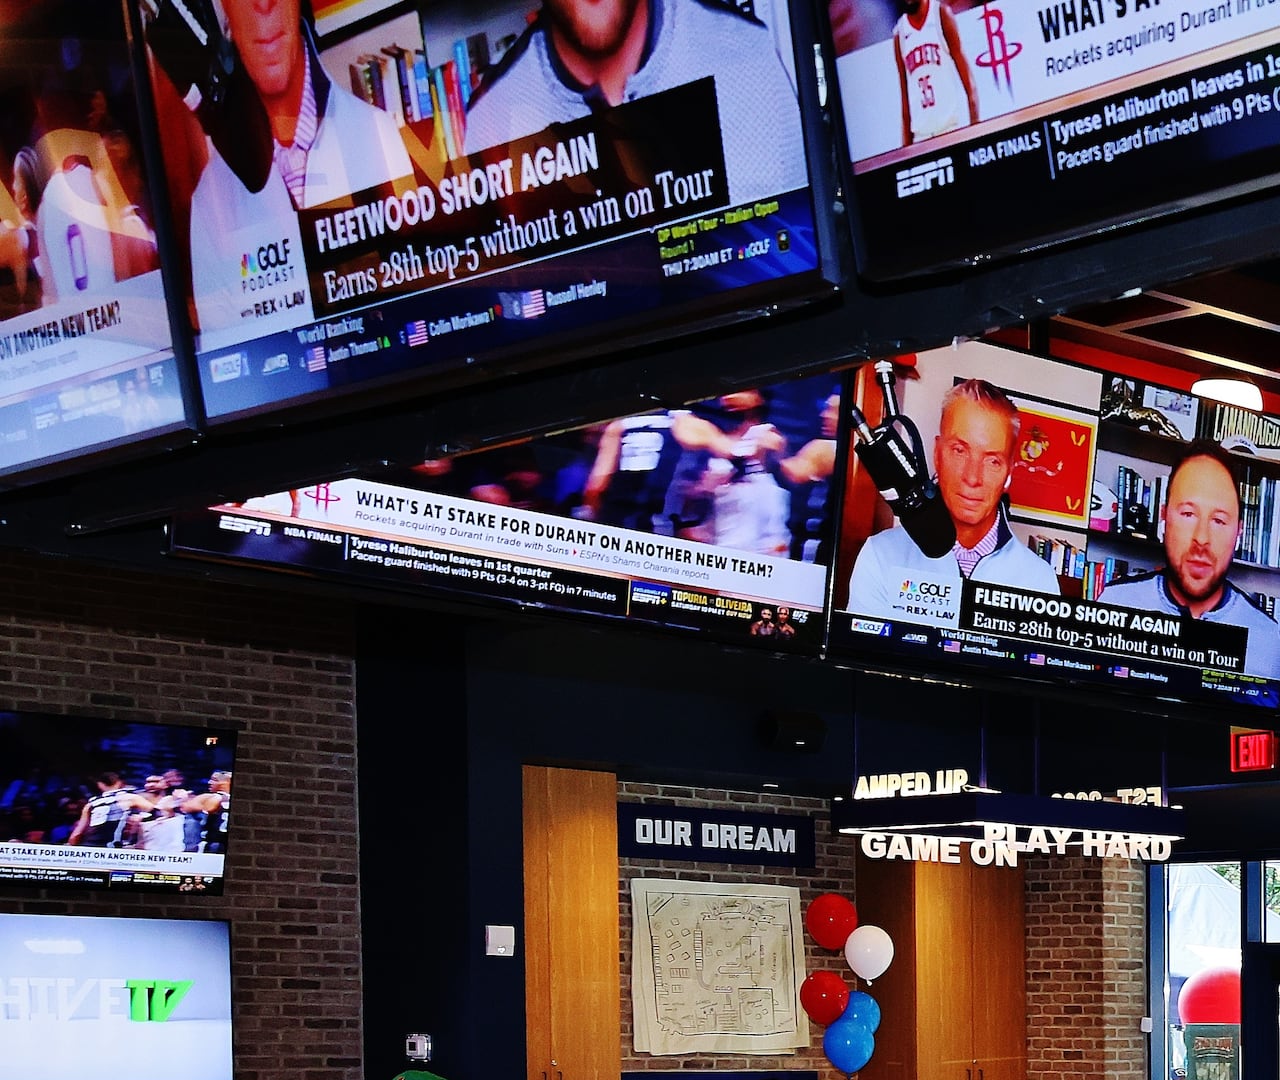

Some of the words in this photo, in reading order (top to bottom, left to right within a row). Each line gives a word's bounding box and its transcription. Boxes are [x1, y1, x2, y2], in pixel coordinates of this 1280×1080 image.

[1050, 113, 1102, 144] Tyrese
[1103, 86, 1189, 126] Haliburton
[1190, 69, 1244, 99] leaves
[1245, 61, 1264, 82] in
[969, 144, 995, 168] NBA
[997, 131, 1041, 161] FINALS
[1056, 145, 1102, 170] Pacers
[1103, 128, 1142, 162] guard
[1143, 111, 1198, 144] finished
[1199, 103, 1231, 127] with
[1232, 97, 1244, 119] 9
[1245, 92, 1271, 115] Pts
[315, 185, 435, 252] FLEETWOOD
[437, 158, 513, 214] SHORT
[520, 132, 598, 191] AGAIN
[896, 156, 954, 198] ESPN
[257, 238, 290, 271] GOLF
[323, 267, 377, 303] Earns
[378, 244, 424, 287] 28th
[425, 236, 479, 277] top-5
[480, 208, 559, 257] without
[563, 210, 577, 236] a
[579, 197, 620, 229] win
[624, 187, 654, 218] on
[655, 168, 713, 208] Tour
[242, 266, 296, 294] PODCAST
[356, 490, 418, 514] WHAT'S
[423, 503, 443, 519] AT
[447, 507, 495, 528] STAKE
[500, 516, 529, 535] FOR
[535, 522, 596, 546] DURANT
[600, 534, 620, 551] ON
[624, 539, 691, 564] ANOTHER
[695, 551, 727, 569] NEW
[731, 558, 772, 578] TEAM?
[350, 536, 387, 551] Tyrese
[388, 542, 447, 561] Haliburton
[448, 552, 482, 567] leaves
[483, 558, 494, 569] in
[495, 560, 511, 572] 1st
[512, 565, 552, 578] quarter
[900, 592, 951, 606] PODCAST
[920, 582, 951, 598] GOLF
[906, 605, 928, 616] REX
[935, 610, 955, 620] LAV
[974, 587, 1071, 618] FLEETWOOD
[1074, 604, 1128, 627] SHORT
[1129, 614, 1179, 636] AGAIN
[973, 611, 1015, 632] Earns
[1018, 620, 1051, 638] 28th
[1056, 626, 1093, 647] top-5
[1096, 633, 1147, 653] without
[1150, 644, 1158, 655] a
[1161, 643, 1185, 659] win
[1187, 650, 1204, 662] on
[1207, 649, 1238, 667] Tour
[1238, 733, 1268, 769] EXIT
[853, 771, 930, 800] AMPED
[935, 768, 968, 796] UP
[635, 818, 693, 847] OUR
[701, 822, 797, 855] DREAM
[861, 832, 961, 865] GAME
[970, 835, 1018, 868] ON
[984, 822, 1072, 855] PLAY
[1083, 830, 1172, 861] HARD
